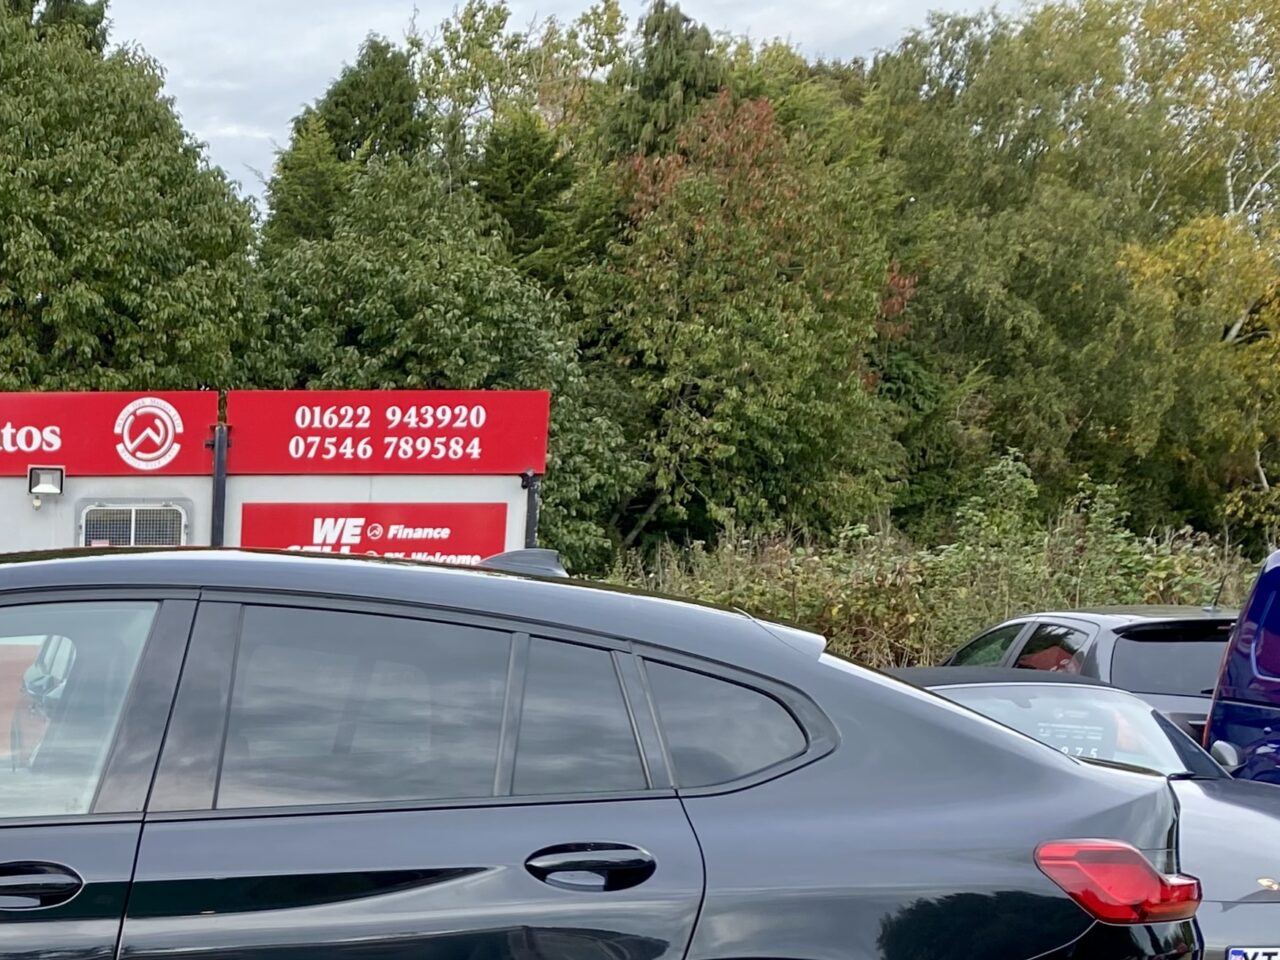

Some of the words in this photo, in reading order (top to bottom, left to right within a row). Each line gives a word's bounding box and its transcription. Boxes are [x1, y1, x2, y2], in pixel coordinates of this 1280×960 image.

[295, 405, 371, 428] 01622
[385, 405, 487, 429] 943920
[288, 435, 373, 459] 07546
[384, 436, 482, 459] 789584
[313, 518, 365, 544] WE
[387, 525, 451, 540] Finance
